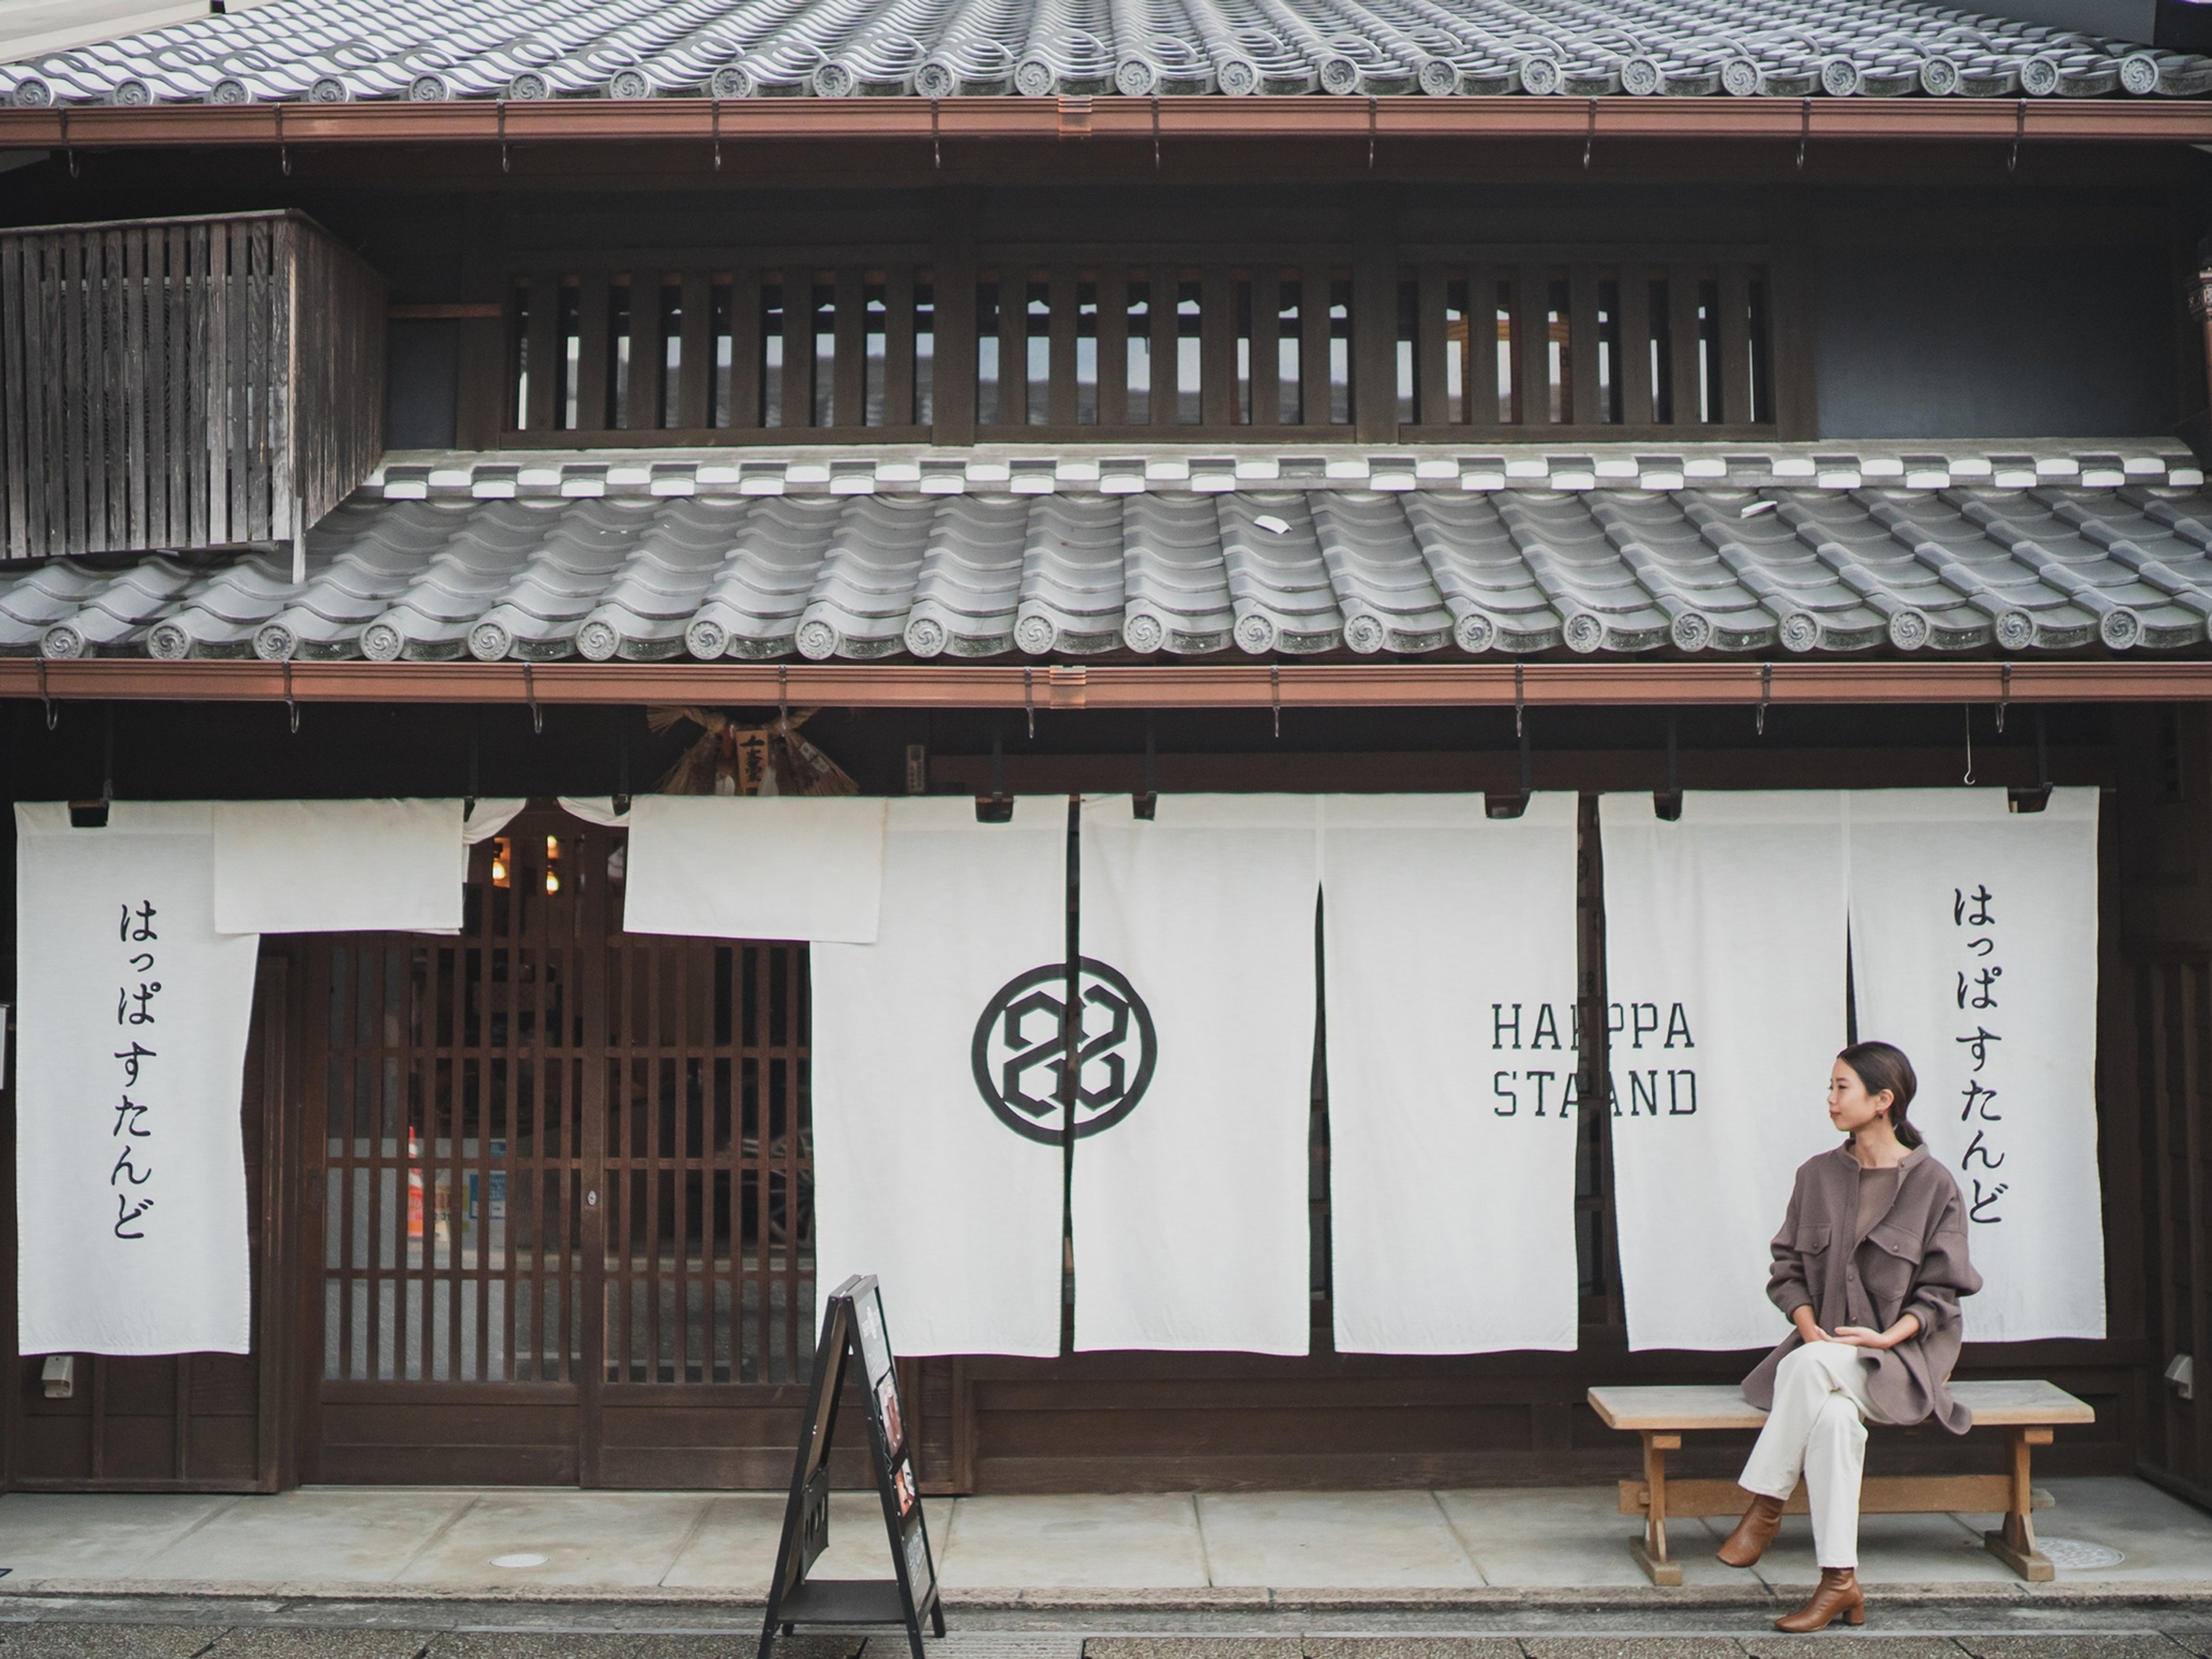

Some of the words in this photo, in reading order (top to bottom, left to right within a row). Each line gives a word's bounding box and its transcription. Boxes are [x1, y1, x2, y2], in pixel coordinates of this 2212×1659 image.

[111, 900, 161, 1238] はっぱすたんど
[1492, 1003, 1695, 1051] HAPPA
[1494, 1070, 1696, 1118] STAND
[1954, 884, 2009, 1224] はっぱすたんど
